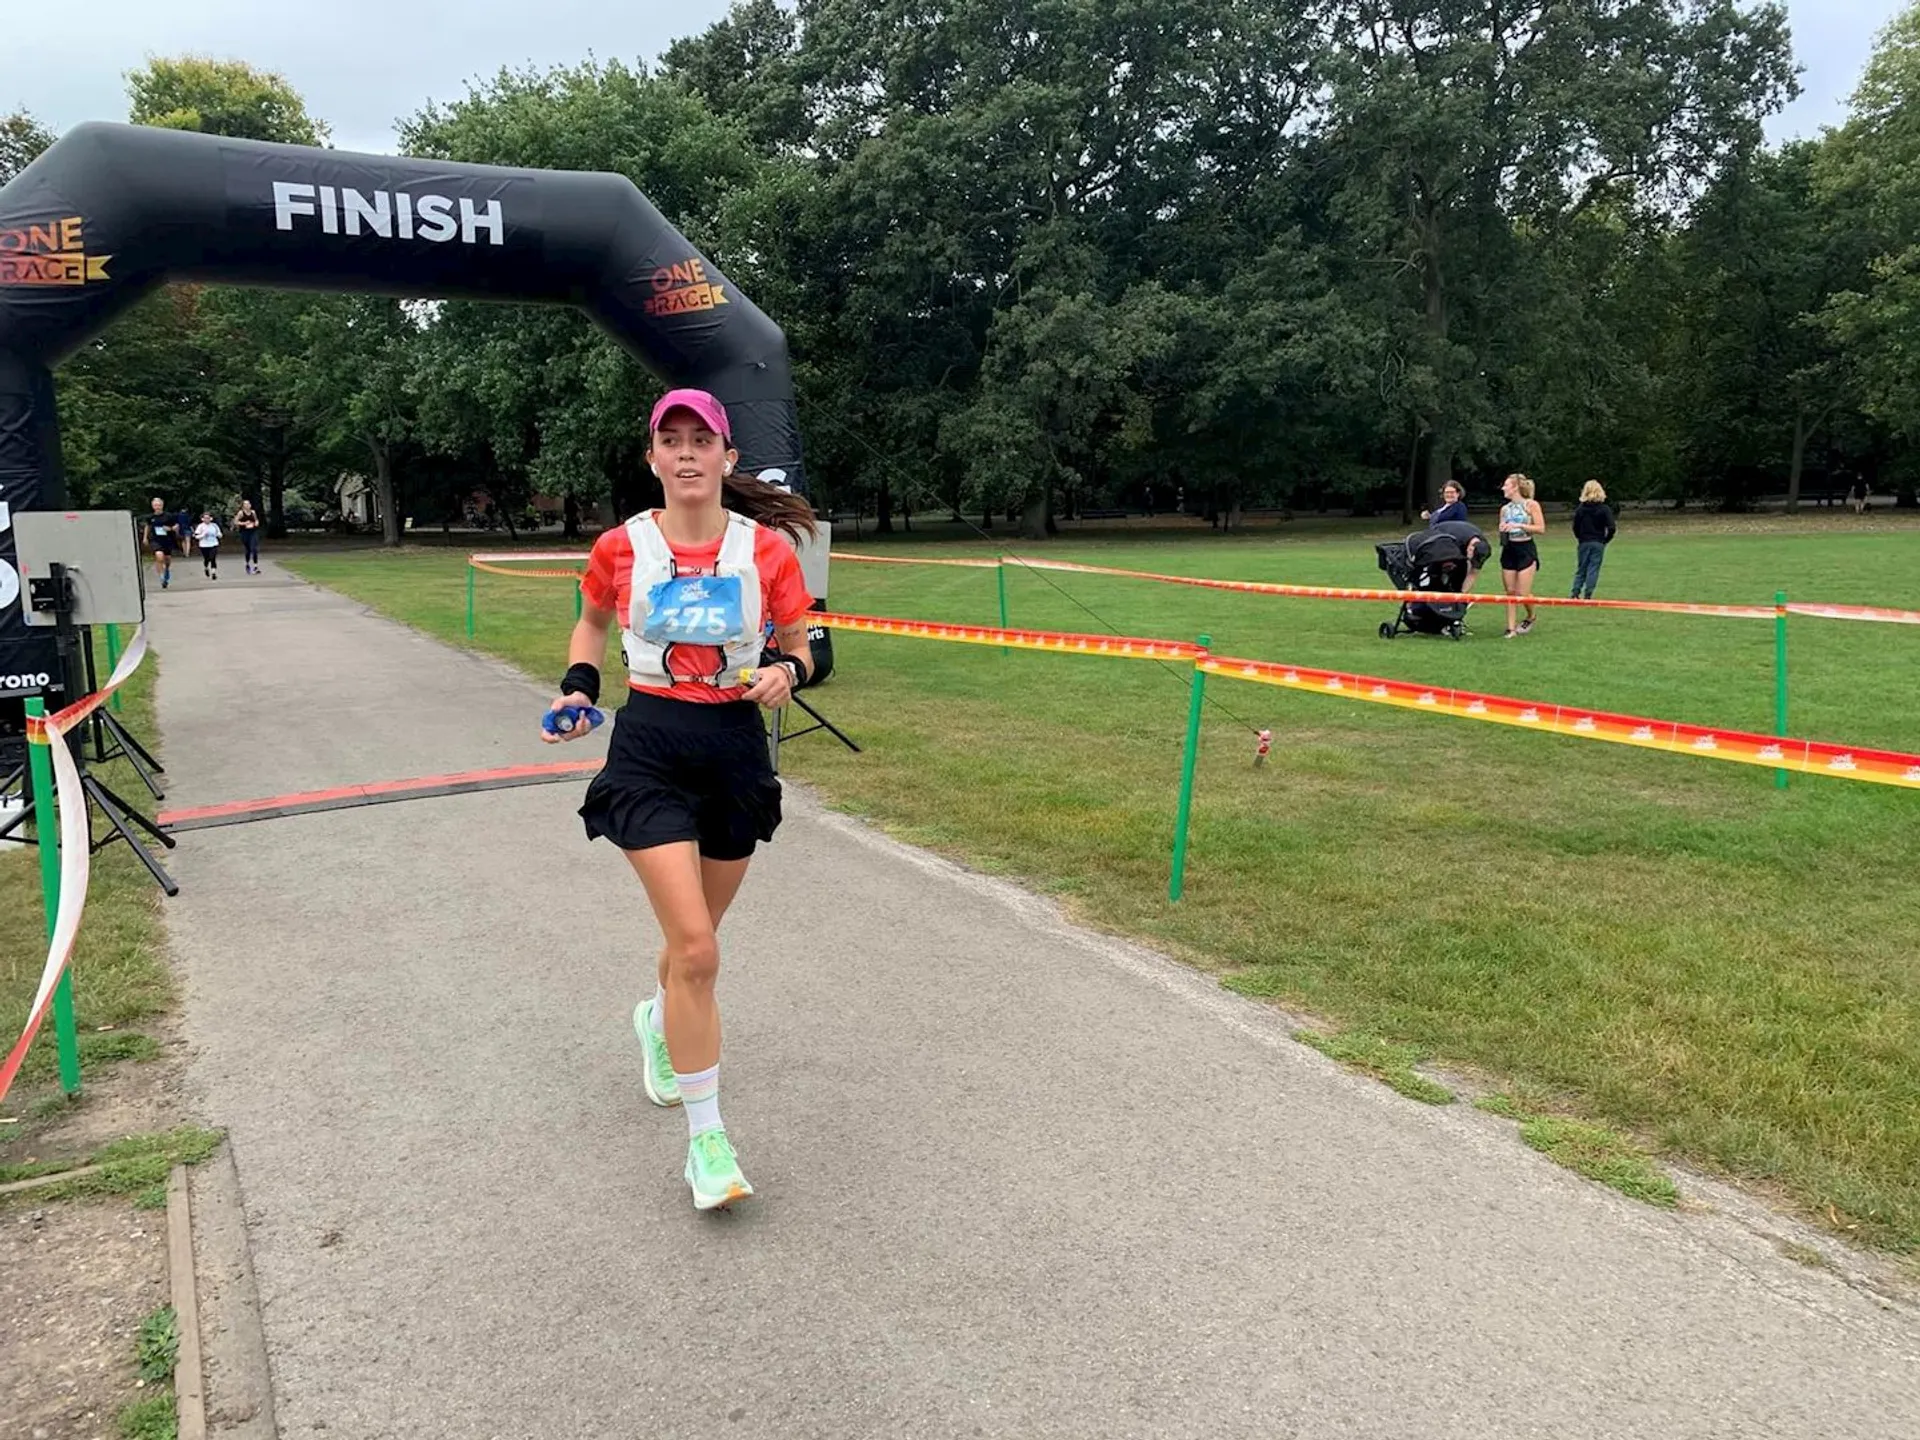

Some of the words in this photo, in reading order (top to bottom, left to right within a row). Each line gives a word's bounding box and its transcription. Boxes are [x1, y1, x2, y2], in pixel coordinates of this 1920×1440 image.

[272, 181, 504, 245] FINISH
[0, 217, 84, 251] ONE
[1, 259, 80, 281] RACE
[651, 258, 707, 292] ONE
[658, 289, 711, 313] RACE
[662, 607, 727, 635] 375
